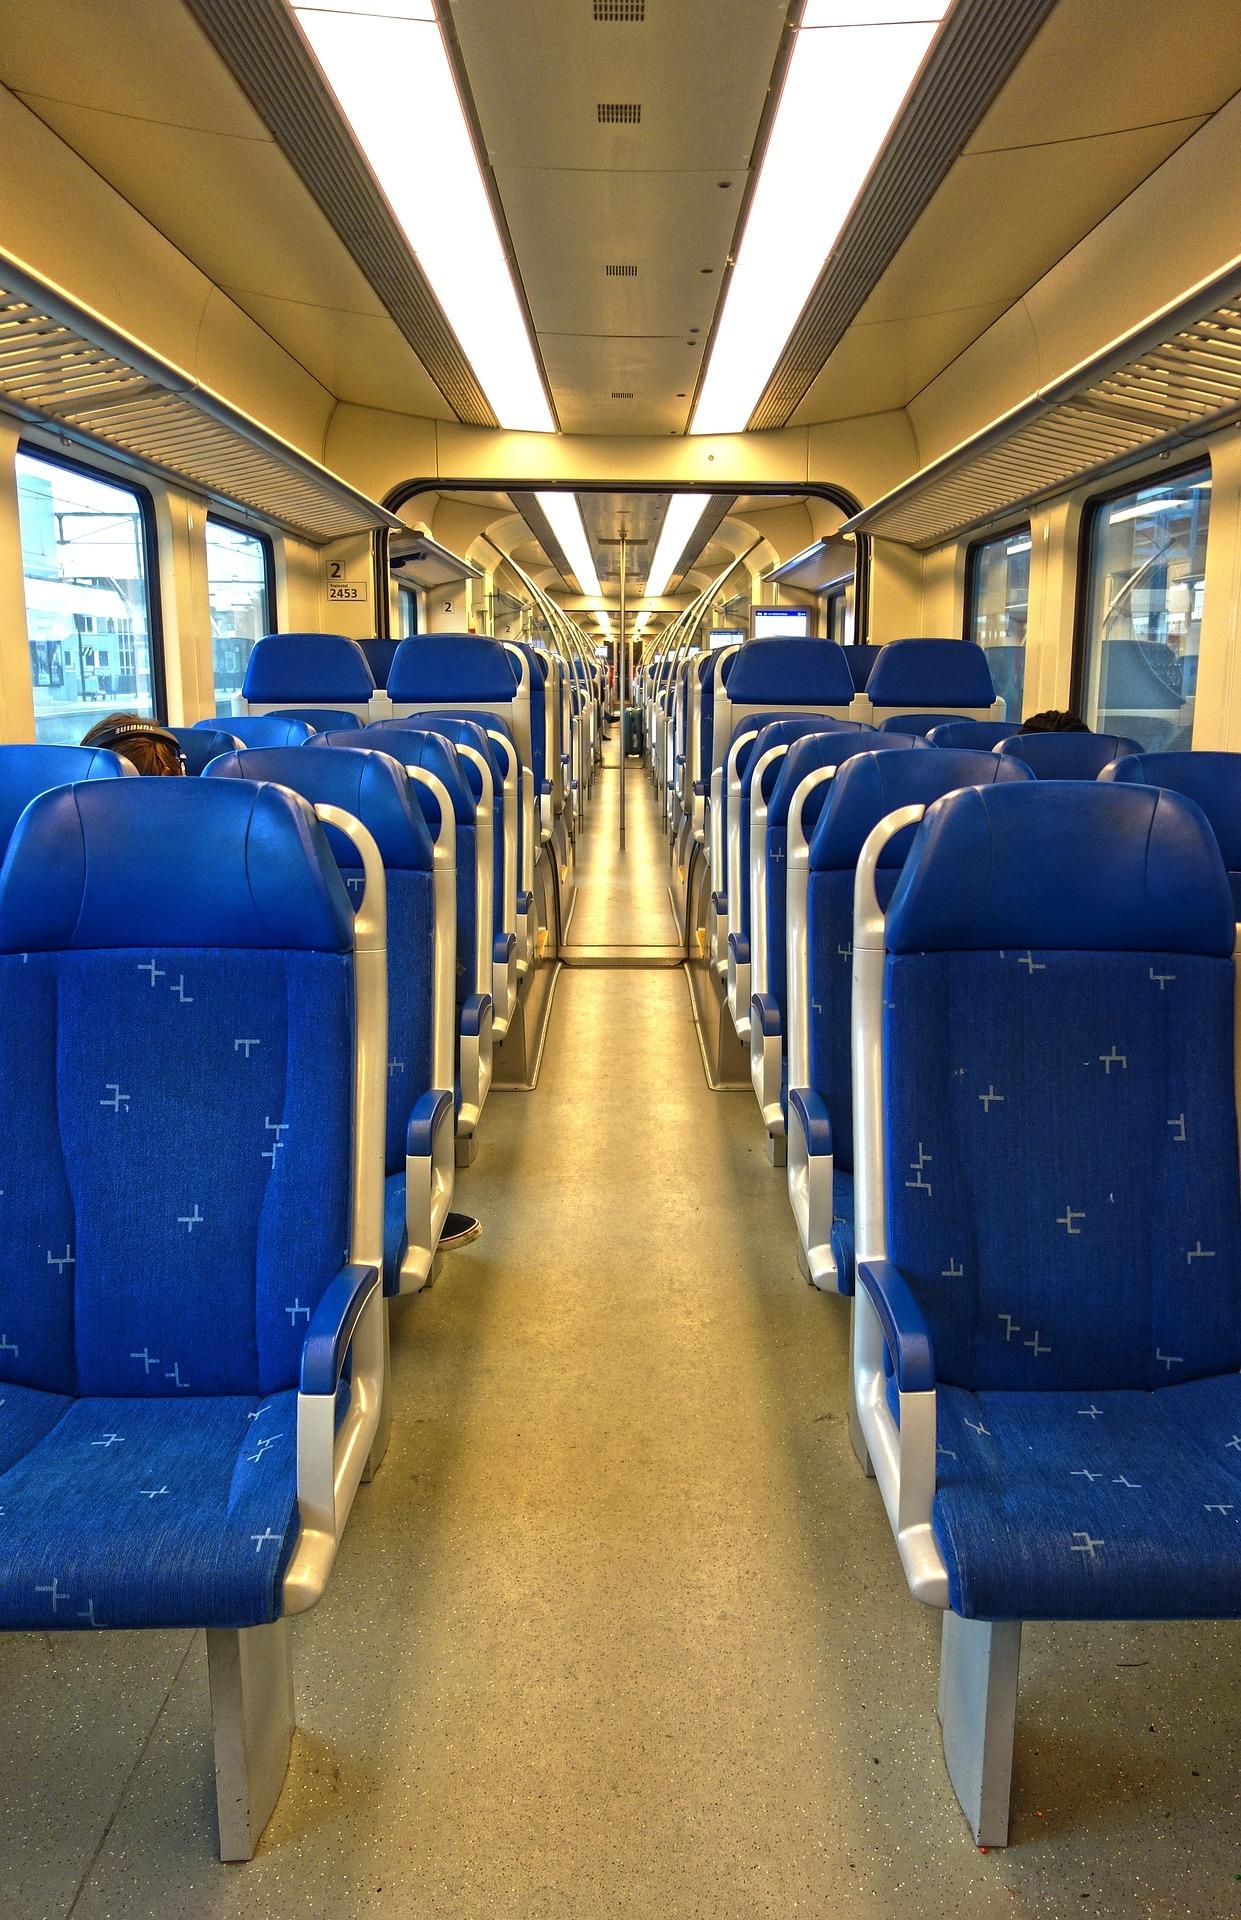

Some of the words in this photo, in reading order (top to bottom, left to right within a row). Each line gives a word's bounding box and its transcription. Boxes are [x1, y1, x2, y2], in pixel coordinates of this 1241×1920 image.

[330, 562, 342, 578] 2
[330, 588, 358, 598] 2453
[444, 602, 452, 613] 2
[505, 625, 511, 633] 2
